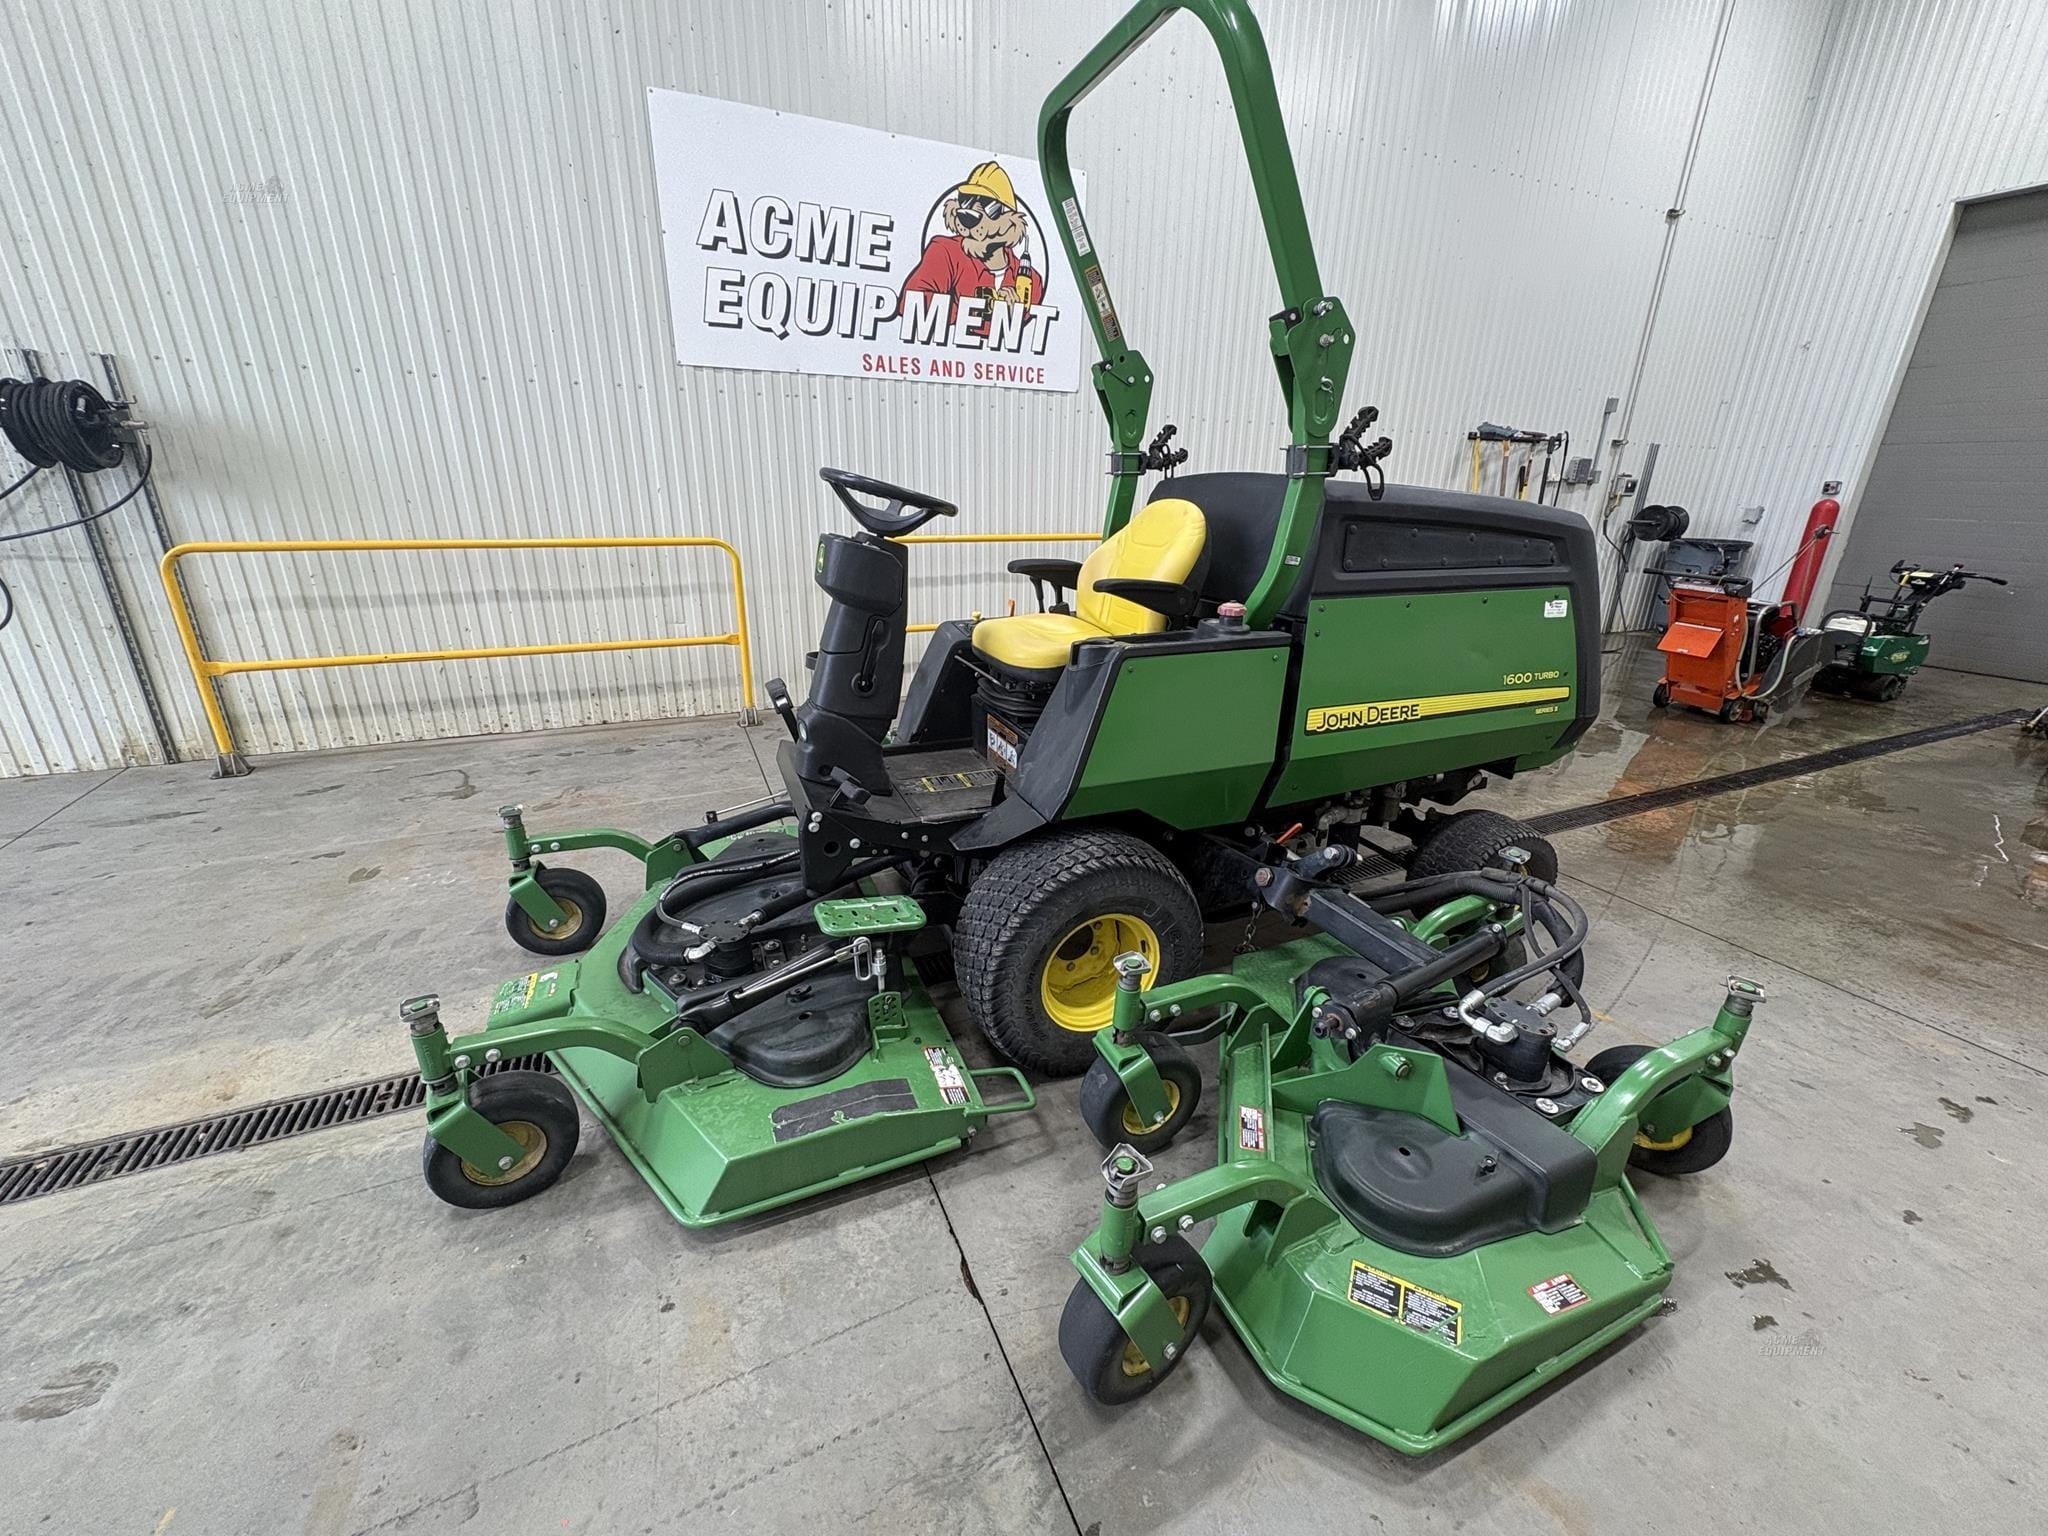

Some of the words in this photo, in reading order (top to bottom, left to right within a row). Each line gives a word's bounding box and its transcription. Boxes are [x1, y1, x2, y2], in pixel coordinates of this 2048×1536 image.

[696, 188, 895, 273] ACME
[703, 266, 1060, 356] EQUIPMENT
[862, 353, 921, 377] SALES
[929, 358, 967, 380] AND
[973, 361, 1045, 384] SERVICE
[1503, 672, 1533, 685] 1600
[1534, 670, 1560, 681] TURBO
[1316, 709, 1363, 731] JOHN
[1367, 703, 1420, 724] DEERE
